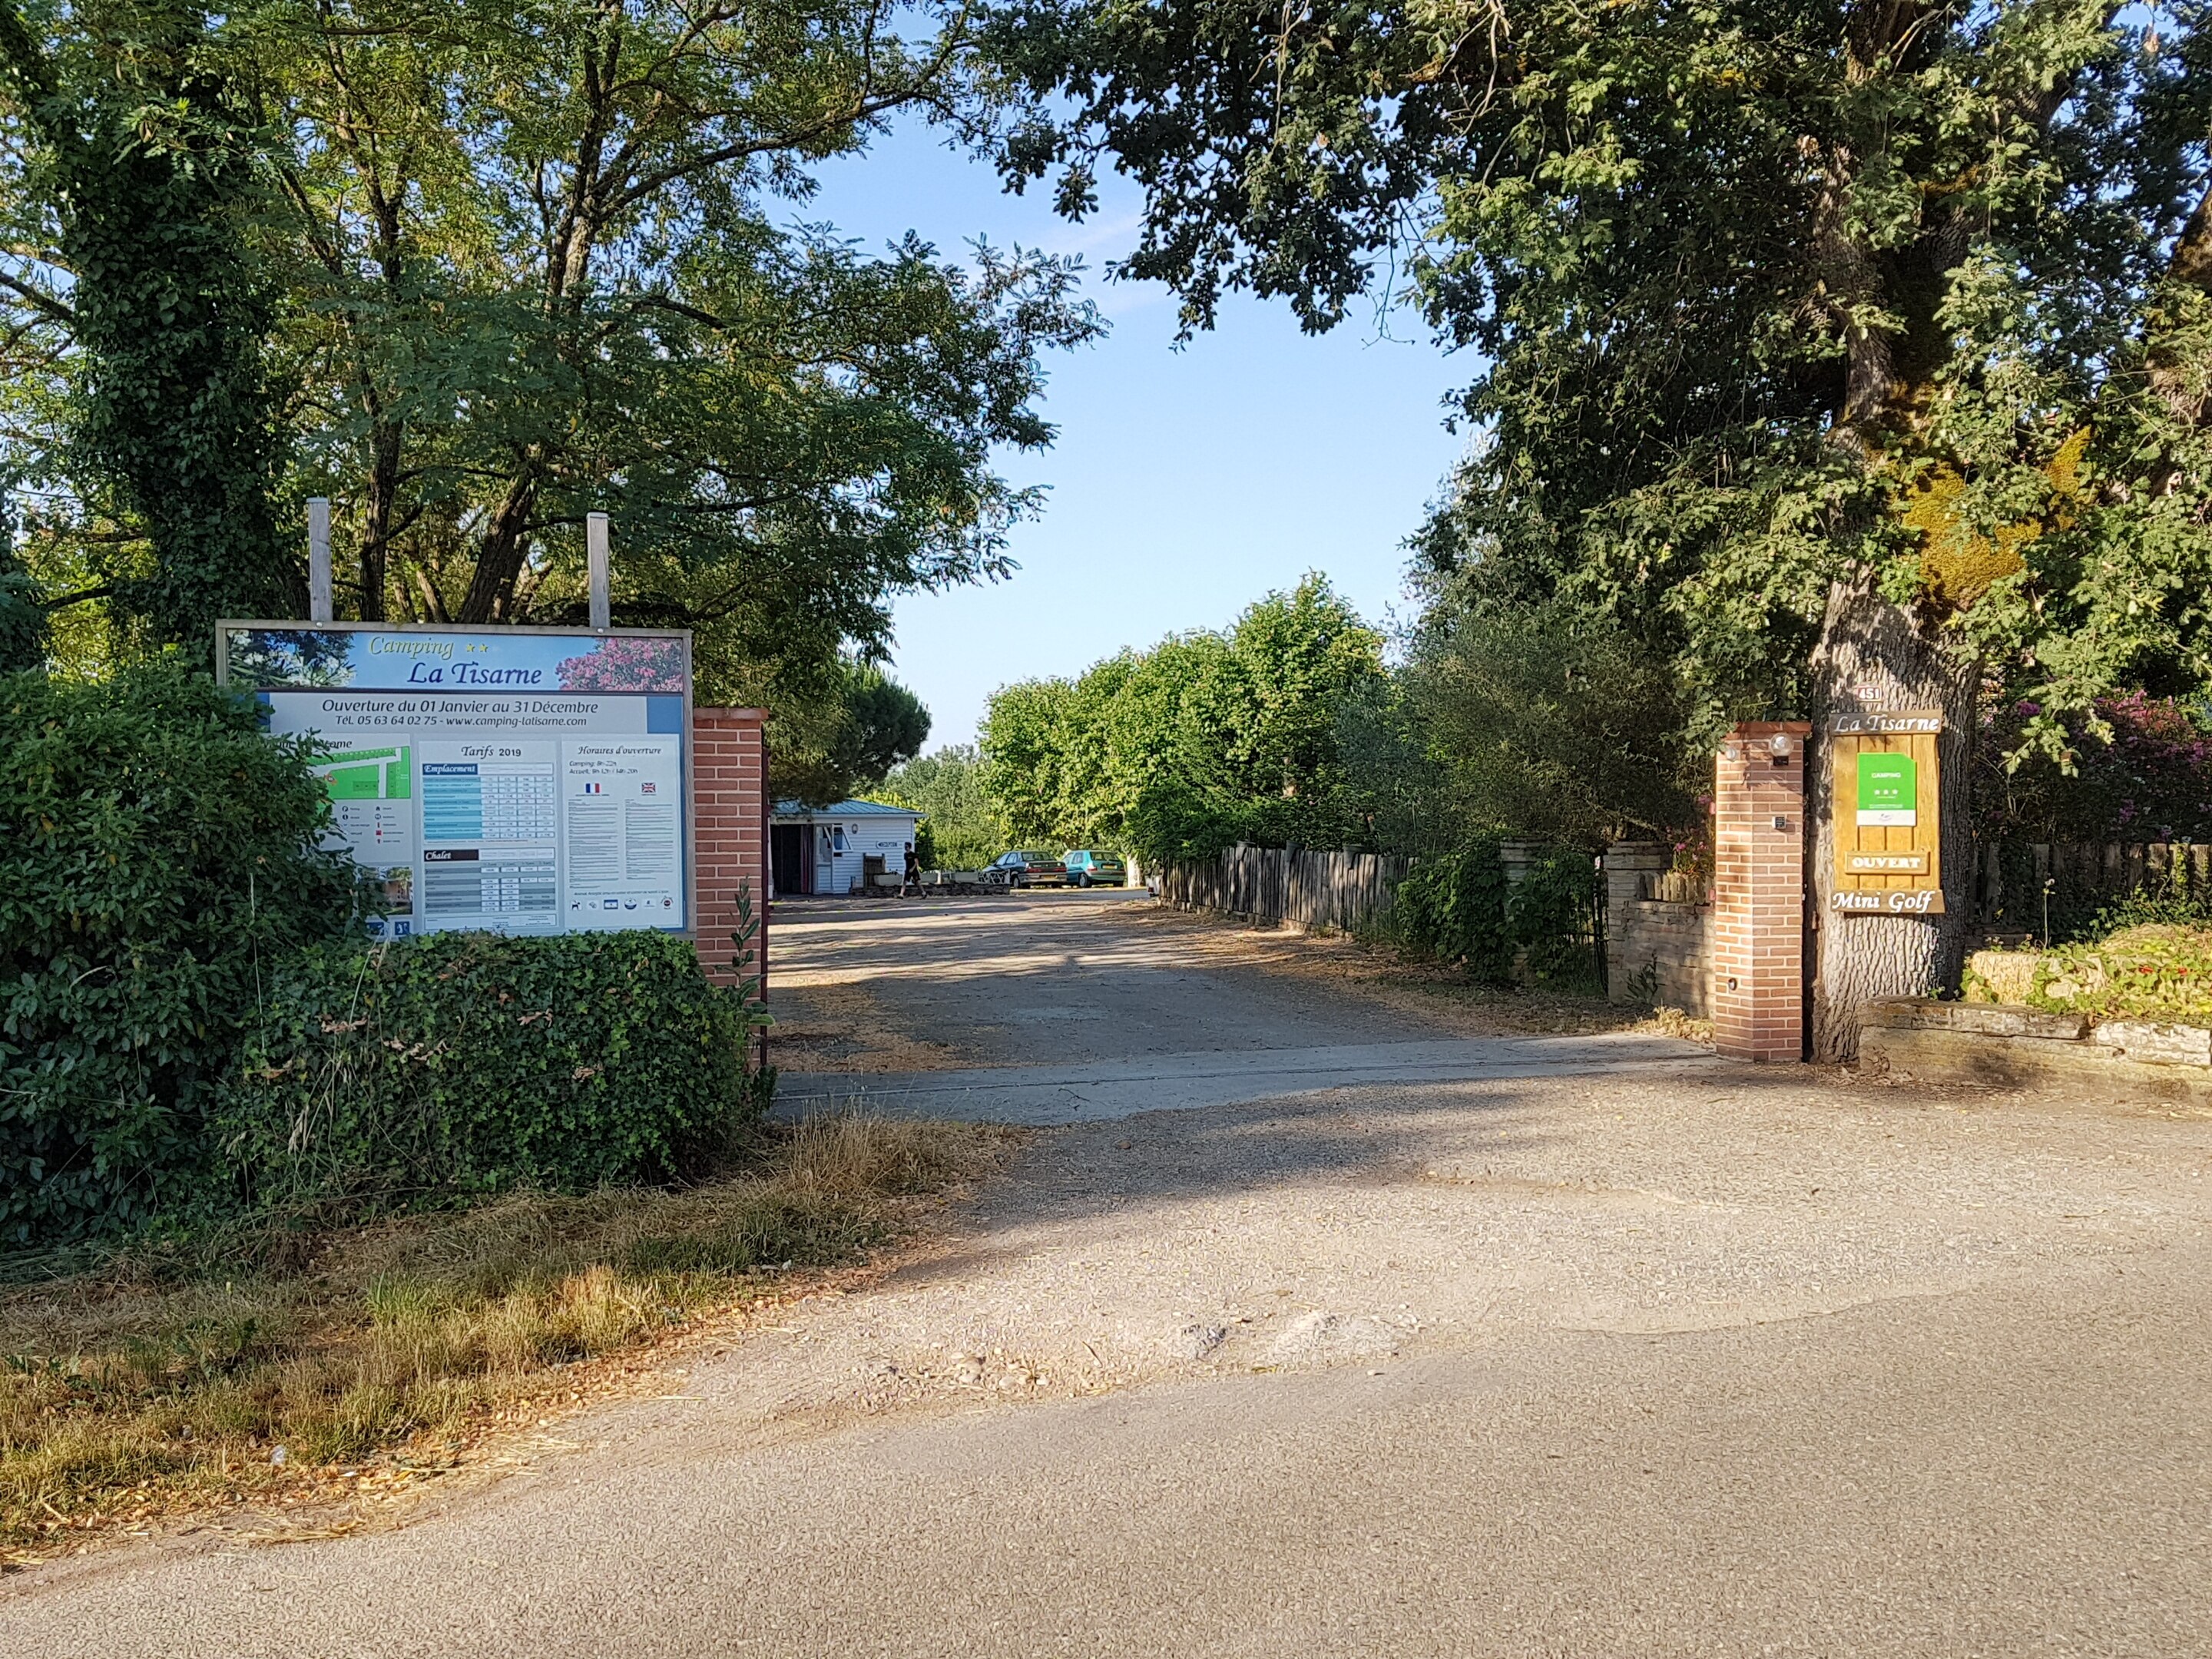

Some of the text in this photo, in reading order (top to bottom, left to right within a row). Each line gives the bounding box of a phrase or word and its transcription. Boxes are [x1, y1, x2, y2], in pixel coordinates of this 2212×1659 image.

[370, 636, 454, 661] Camping
[407, 661, 542, 684] La Tisarne
[322, 699, 598, 713] Ouverture du 01 Janvier au 31 Décembre
[357, 716, 372, 725] 05
[374, 716, 387, 725] 63
[390, 716, 404, 725] 64
[407, 716, 421, 725] 02
[424, 716, 437, 725] 75
[446, 716, 587, 728] www.camping-latisarne.com
[1834, 714, 1939, 732] La Tisarne
[461, 745, 522, 759] Tarifs 2019
[578, 745, 661, 755] Horaires d'ouverture
[424, 764, 475, 774] Emplacement
[425, 850, 452, 860] Chalet
[1852, 857, 1920, 868] OUVERT
[1832, 890, 1936, 913] Mini Golf
